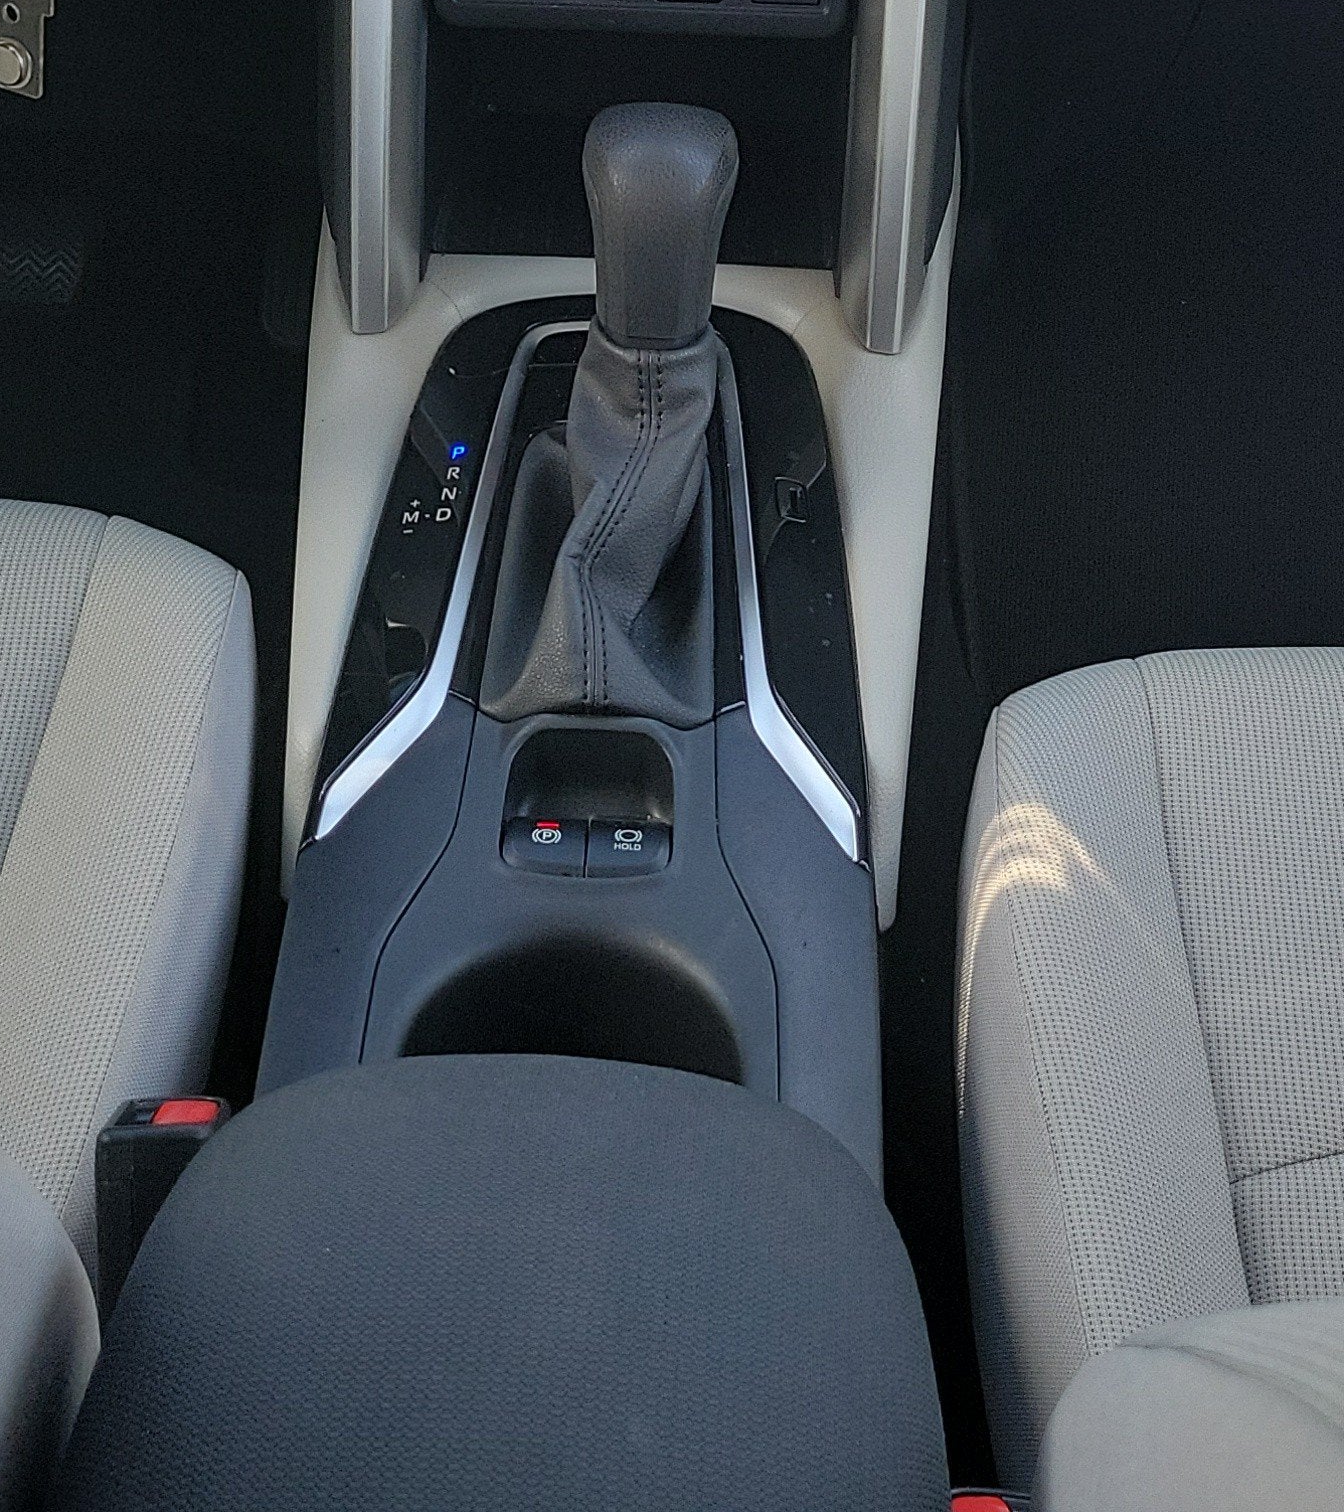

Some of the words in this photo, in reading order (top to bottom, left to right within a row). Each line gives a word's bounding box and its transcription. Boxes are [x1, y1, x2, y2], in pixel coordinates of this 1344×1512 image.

[451, 445, 466, 460] P
[446, 466, 461, 480] R
[440, 486, 458, 502] N
[401, 510, 421, 525] M
[435, 507, 452, 522] D
[613, 842, 642, 851] HOLD
